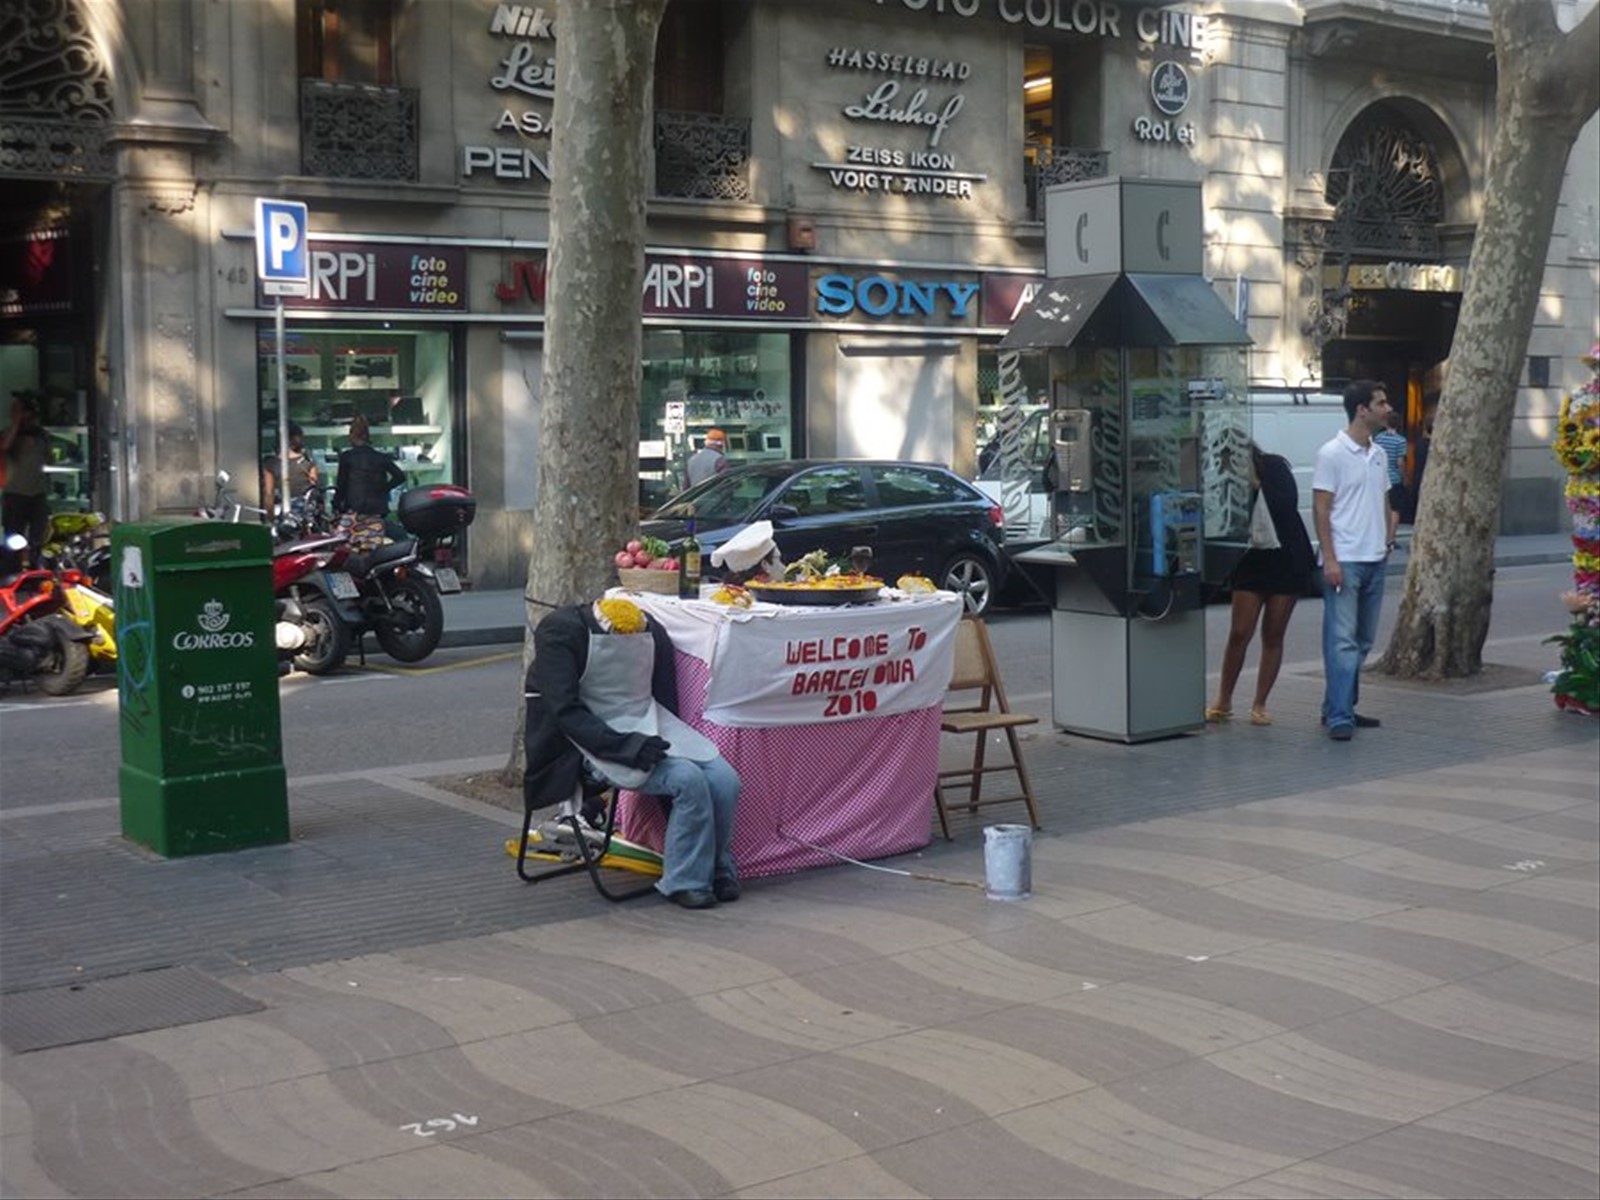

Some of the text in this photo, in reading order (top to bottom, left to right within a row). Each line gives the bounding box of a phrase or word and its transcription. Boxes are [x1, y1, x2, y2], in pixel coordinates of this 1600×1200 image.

[491, 41, 555, 98] Lei
[829, 48, 970, 79] HASSELBLAD
[845, 80, 965, 146] Linhof
[465, 147, 553, 180] PEN
[848, 148, 956, 169] ZEISS IKON
[270, 211, 298, 270] P
[410, 254, 447, 272] foto
[747, 267, 776, 283] foto
[410, 273, 449, 288] cine
[496, 261, 547, 300] JV
[747, 283, 778, 297] cine
[410, 288, 458, 304] video
[747, 297, 786, 312] video
[816, 273, 980, 317] SONY
[824, 690, 877, 717] 2010
